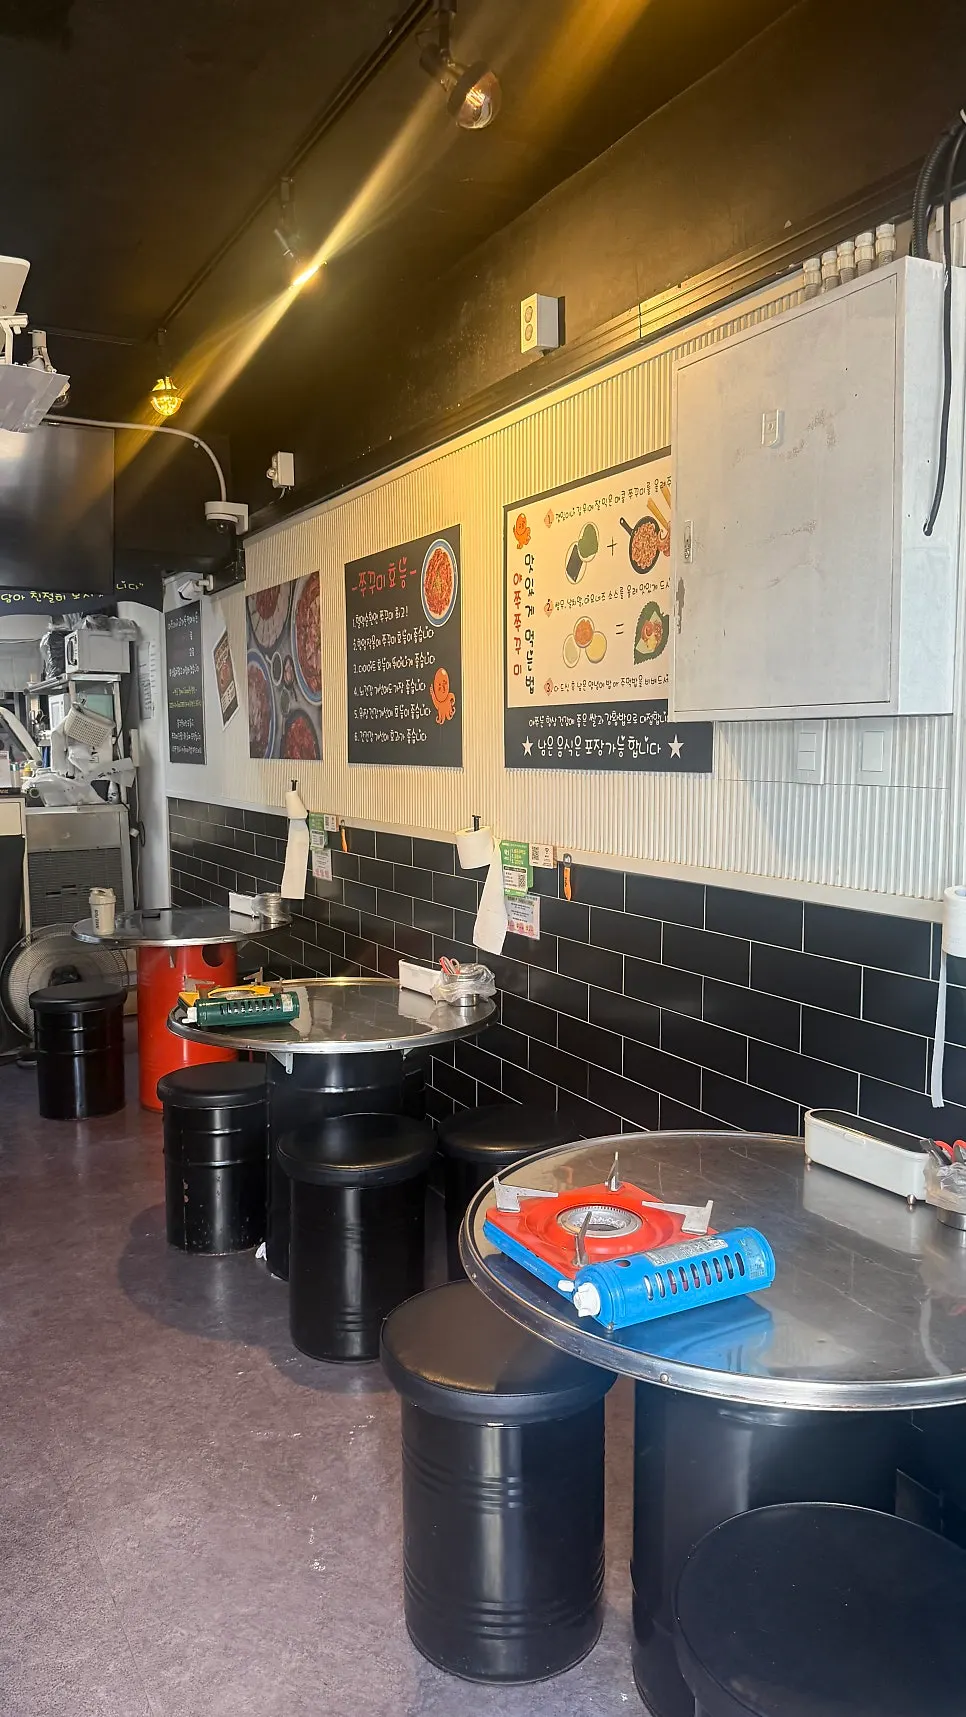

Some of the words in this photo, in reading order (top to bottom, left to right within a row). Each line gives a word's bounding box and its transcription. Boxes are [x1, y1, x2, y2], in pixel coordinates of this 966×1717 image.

[30, 590, 66, 603] 친절히
[608, 586, 624, 600] 소스를
[395, 605, 409, 619] 최고!
[413, 625, 435, 644] 좋습니다
[414, 651, 436, 669] 좋습니다
[405, 678, 427, 695] 좋습니다
[410, 703, 432, 720] 좋습니다
[576, 712, 588, 728] 좋은
[588, 712, 604, 728] 쌀과
[604, 710, 638, 727] 강황밥으로
[406, 727, 427, 744] 좋습니다
[537, 735, 554, 757] 남은
[556, 735, 582, 758] 음식은
